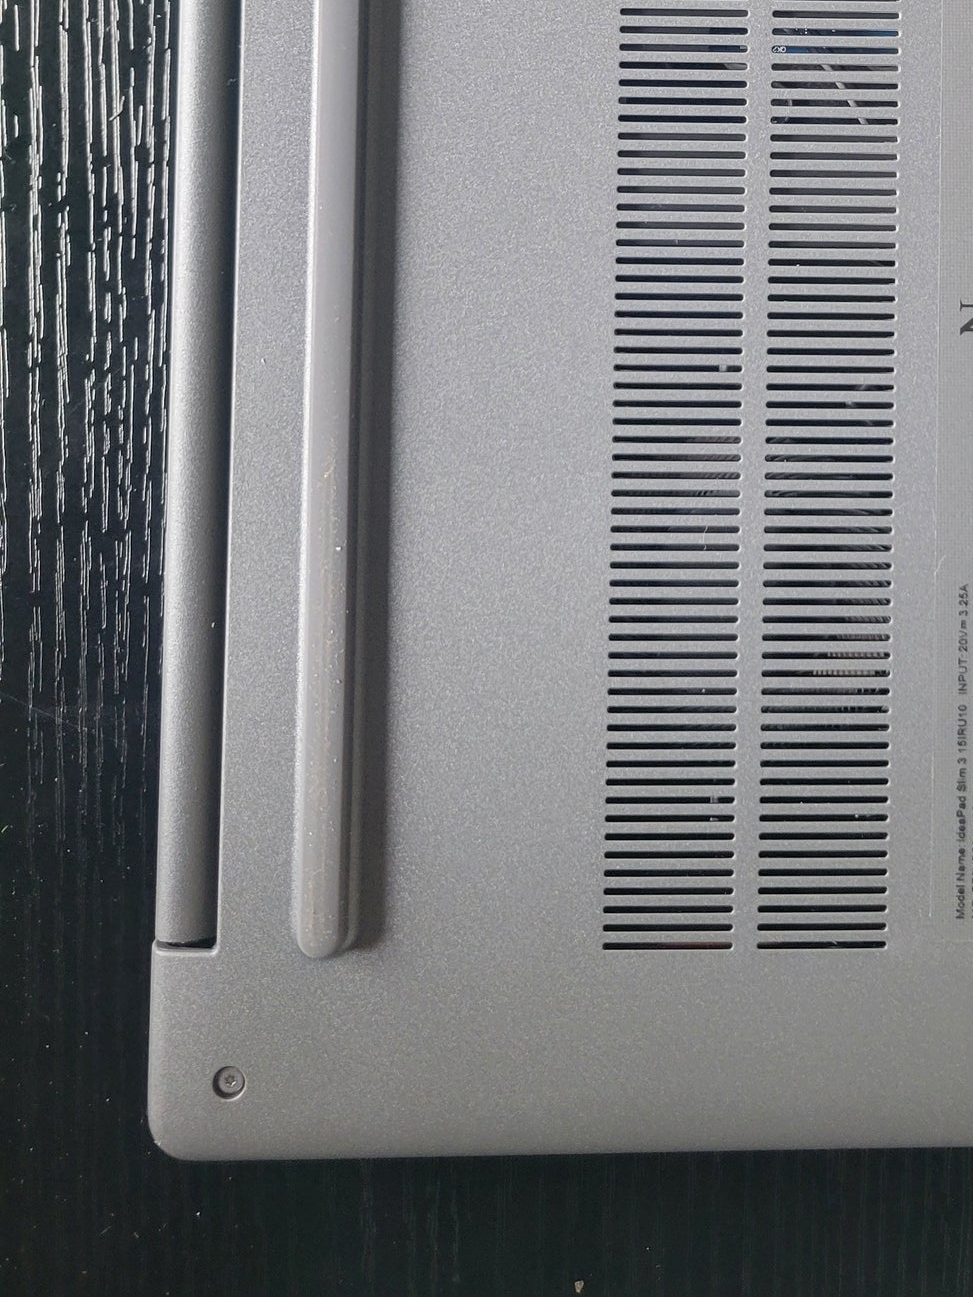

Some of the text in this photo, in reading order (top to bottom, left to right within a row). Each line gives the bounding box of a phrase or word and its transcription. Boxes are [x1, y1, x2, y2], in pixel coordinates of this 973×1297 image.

[957, 704, 968, 753] 15IRU10
[957, 768, 967, 792] Slim
[956, 796, 967, 842] IdeaPad
[955, 845, 966, 881] Name:
[955, 885, 966, 919] Model
